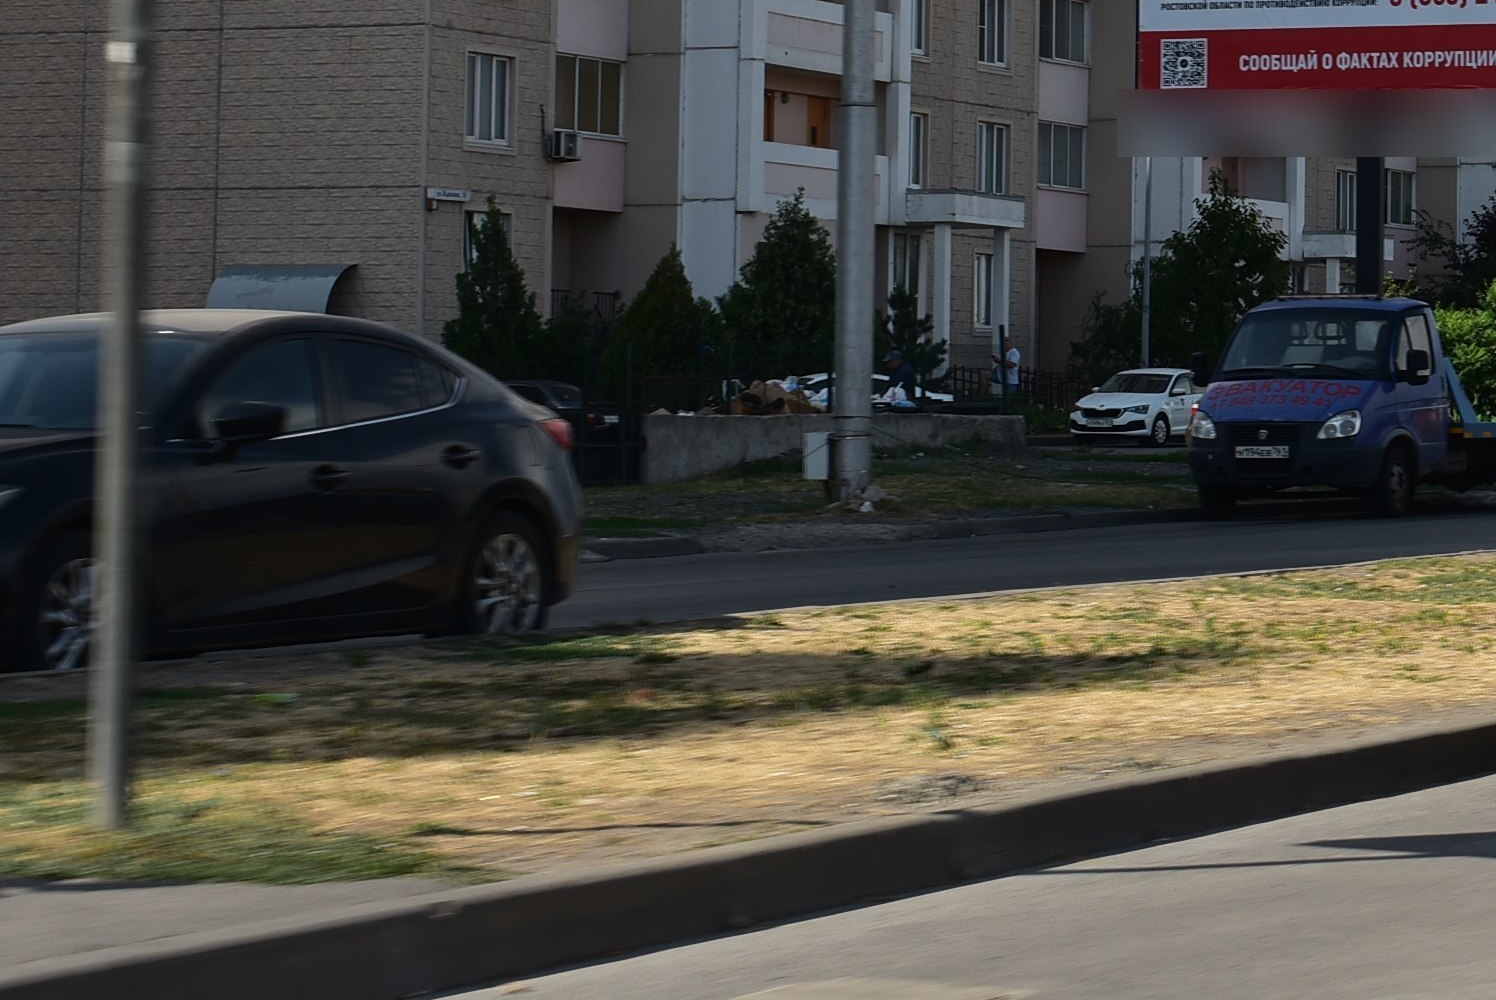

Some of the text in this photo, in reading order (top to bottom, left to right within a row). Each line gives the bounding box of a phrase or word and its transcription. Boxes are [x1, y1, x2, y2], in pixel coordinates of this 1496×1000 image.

[1160, 0, 1208, 11] РОСТОВСКОЙ
[1209, 1, 1242, 10] ОБЛАСТИ
[1239, 49, 1318, 72] СООБЩАЙ
[1322, 53, 1333, 70] О
[1336, 51, 1399, 71] ФАКТАХ
[1208, 380, 1361, 400] ЭВАКУАТОР
